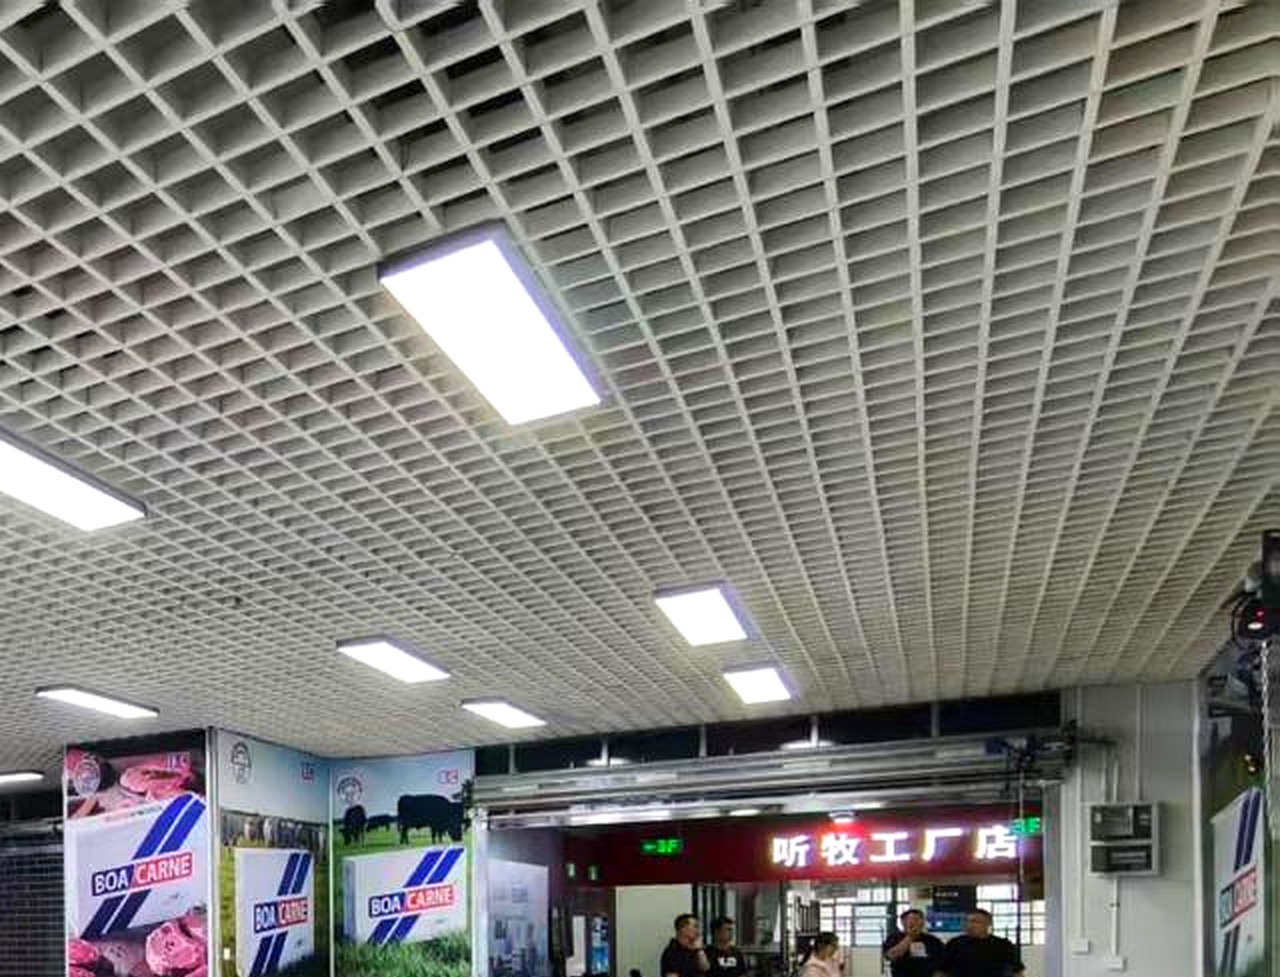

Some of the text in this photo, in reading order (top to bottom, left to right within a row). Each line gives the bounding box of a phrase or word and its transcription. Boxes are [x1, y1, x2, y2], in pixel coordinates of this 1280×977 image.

[772, 824, 1018, 868] 听牧工厂店
[95, 855, 191, 894] BOA CARNE
[256, 904, 275, 930] BOA
[372, 886, 453, 915] BOA CARNE
